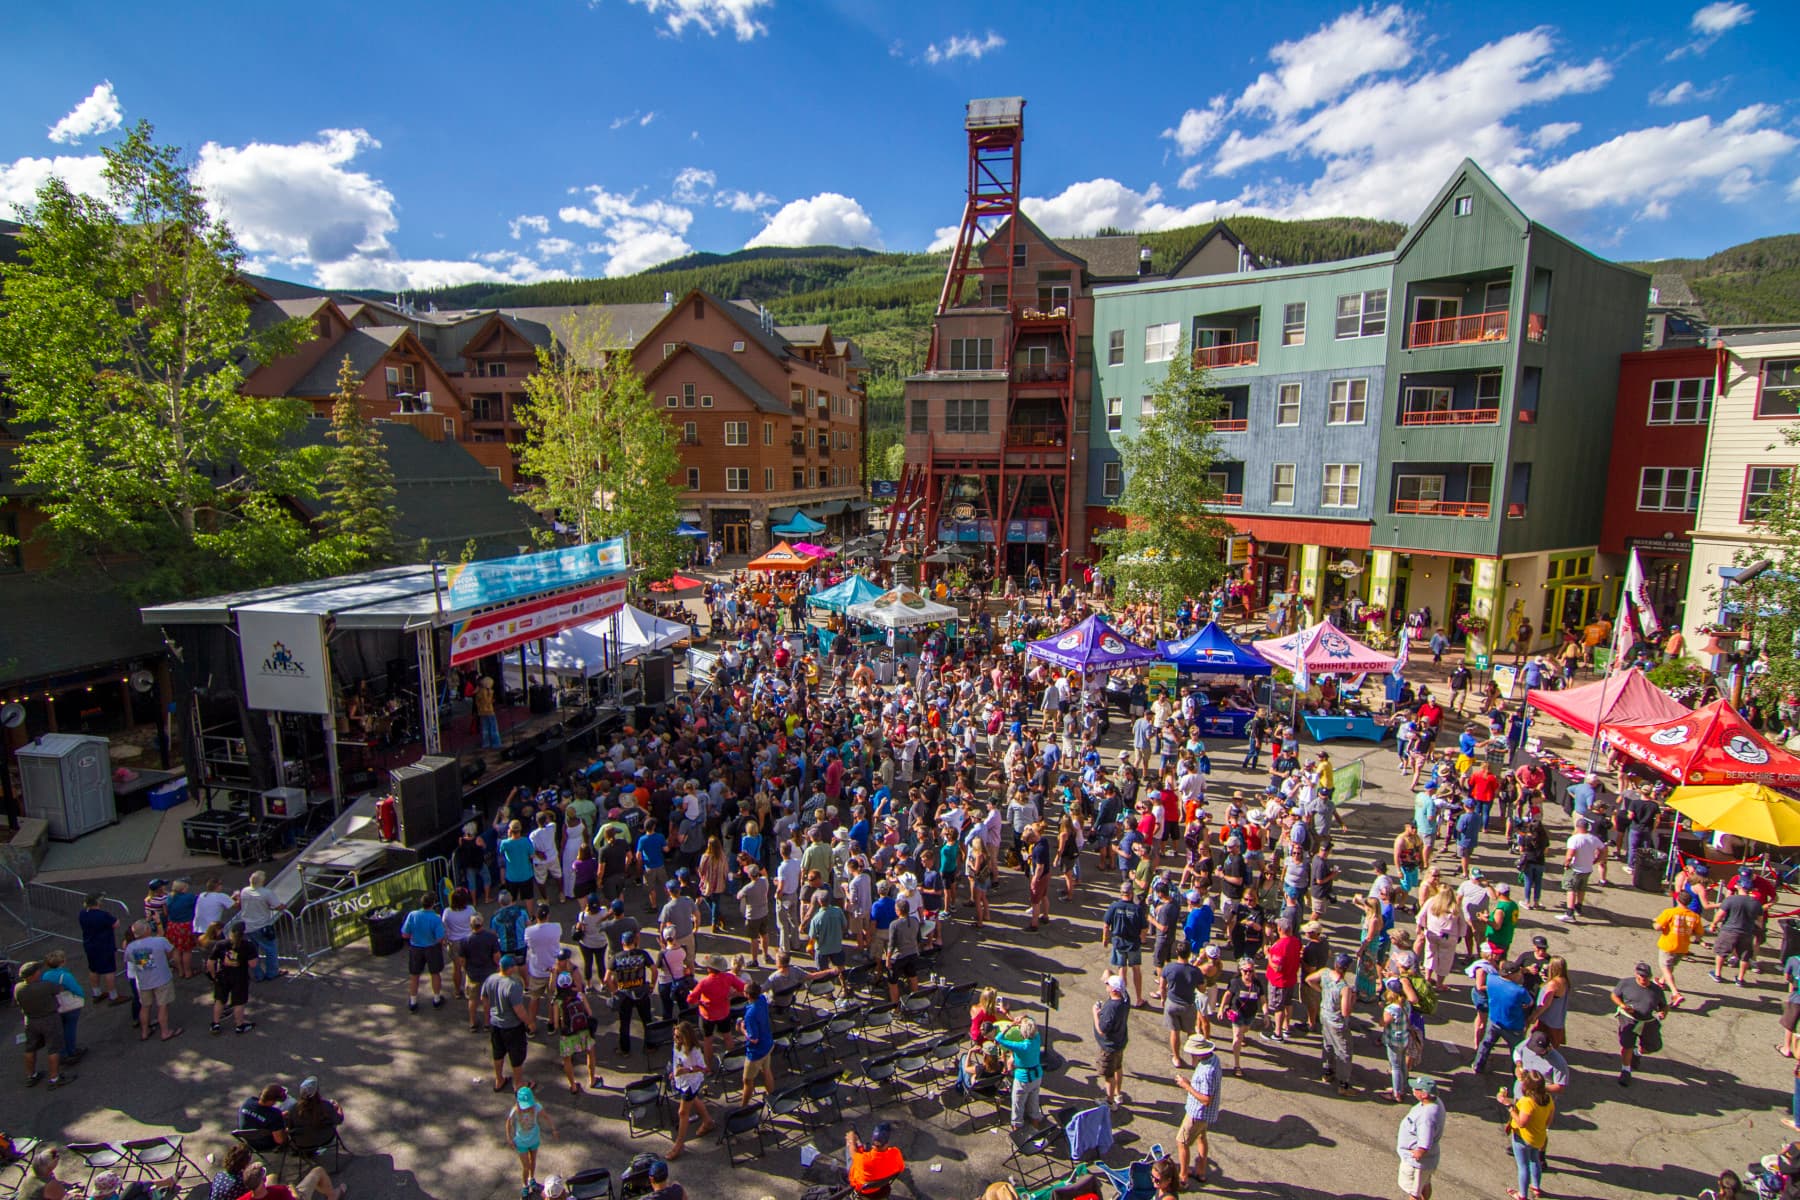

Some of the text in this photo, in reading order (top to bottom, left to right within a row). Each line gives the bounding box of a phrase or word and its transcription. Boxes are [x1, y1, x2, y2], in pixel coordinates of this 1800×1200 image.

[262, 659, 305, 672] APEX
[1308, 661, 1388, 671] OHHHH, BACON!
[328, 892, 372, 920] KNC
